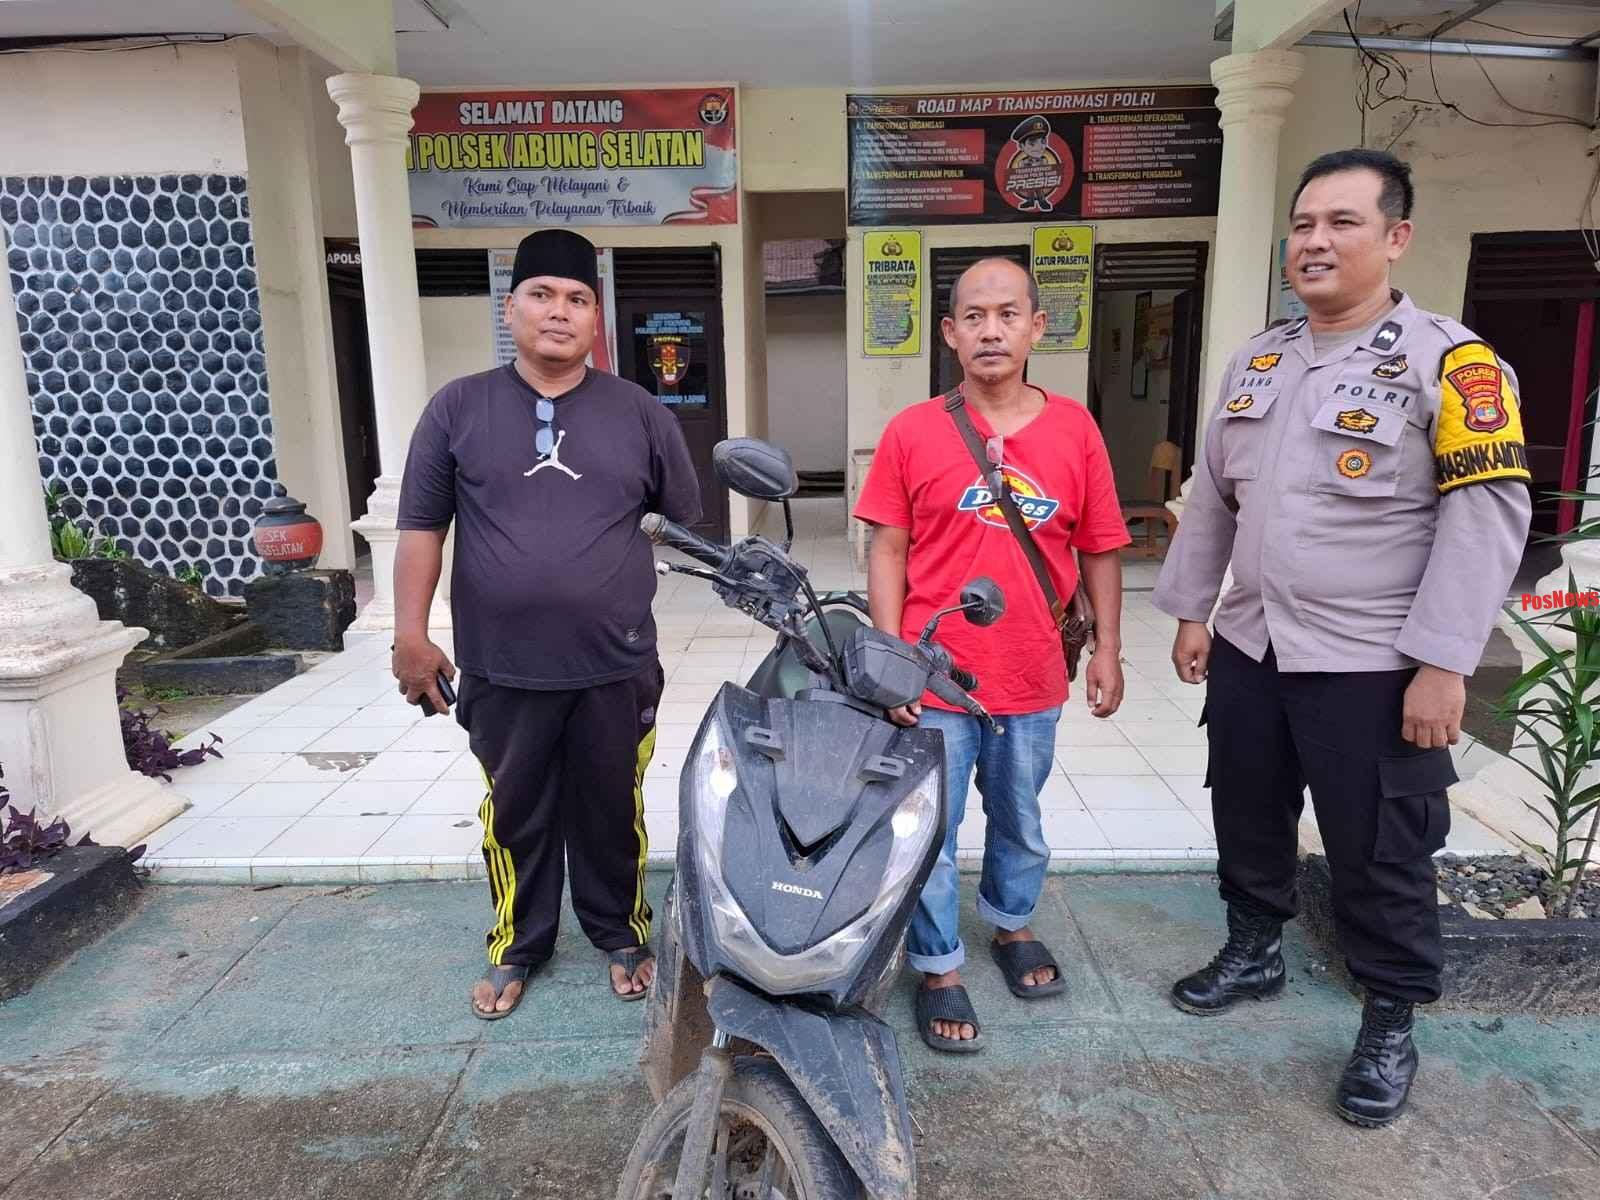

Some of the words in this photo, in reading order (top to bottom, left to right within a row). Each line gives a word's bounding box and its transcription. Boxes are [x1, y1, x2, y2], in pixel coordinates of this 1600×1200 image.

[459, 101, 545, 125] SELAMAT
[551, 99, 623, 124] DATANG
[917, 99, 956, 113] ROAD
[960, 97, 993, 112] MAP
[997, 93, 1108, 112] TRANSFORMASI
[1112, 91, 1156, 107] POLRI
[417, 133, 510, 171] POLSEK
[511, 132, 599, 170] ABUNG
[601, 130, 705, 169] SELATAN
[463, 176, 503, 194] Kami
[506, 176, 537, 198] Siap
[541, 174, 610, 198] Melayani
[617, 176, 630, 192] &
[441, 200, 528, 219] Memberikan
[529, 199, 605, 221] Pelayanan
[606, 198, 656, 217] Terbaik
[868, 260, 916, 272] TRIBRATA
[1035, 256, 1056, 266] CATUR
[1056, 254, 1090, 265] PRASETYA
[1333, 383, 1410, 409] POLRI
[771, 880, 824, 900] HONDA
